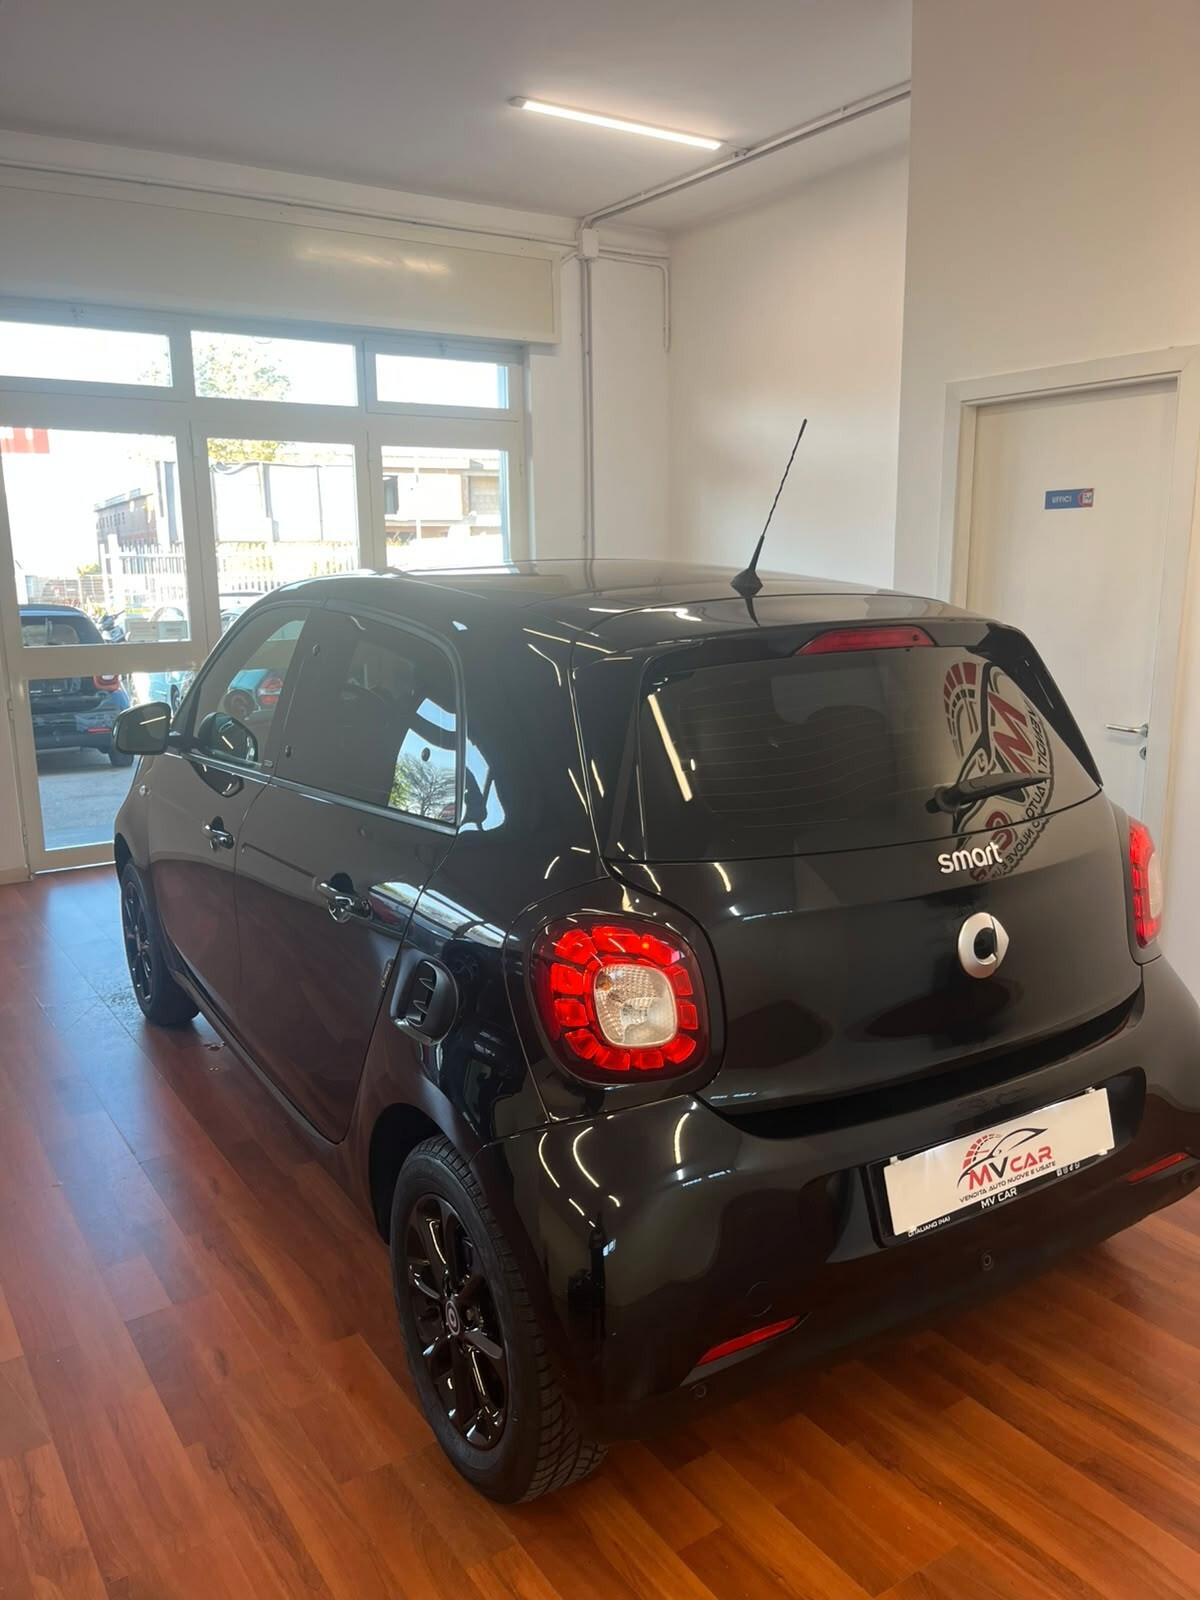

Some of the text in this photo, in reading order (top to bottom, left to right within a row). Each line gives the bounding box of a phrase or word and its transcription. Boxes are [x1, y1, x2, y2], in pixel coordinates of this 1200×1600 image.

[938, 841, 1003, 874] smart
[960, 1187, 987, 1203] VENDITA
[988, 1180, 1007, 1192] AUTO
[1007, 1170, 1030, 1184] NUOVE
[1036, 1160, 1056, 1173] USATE
[980, 1187, 1018, 1209] MV CAR
